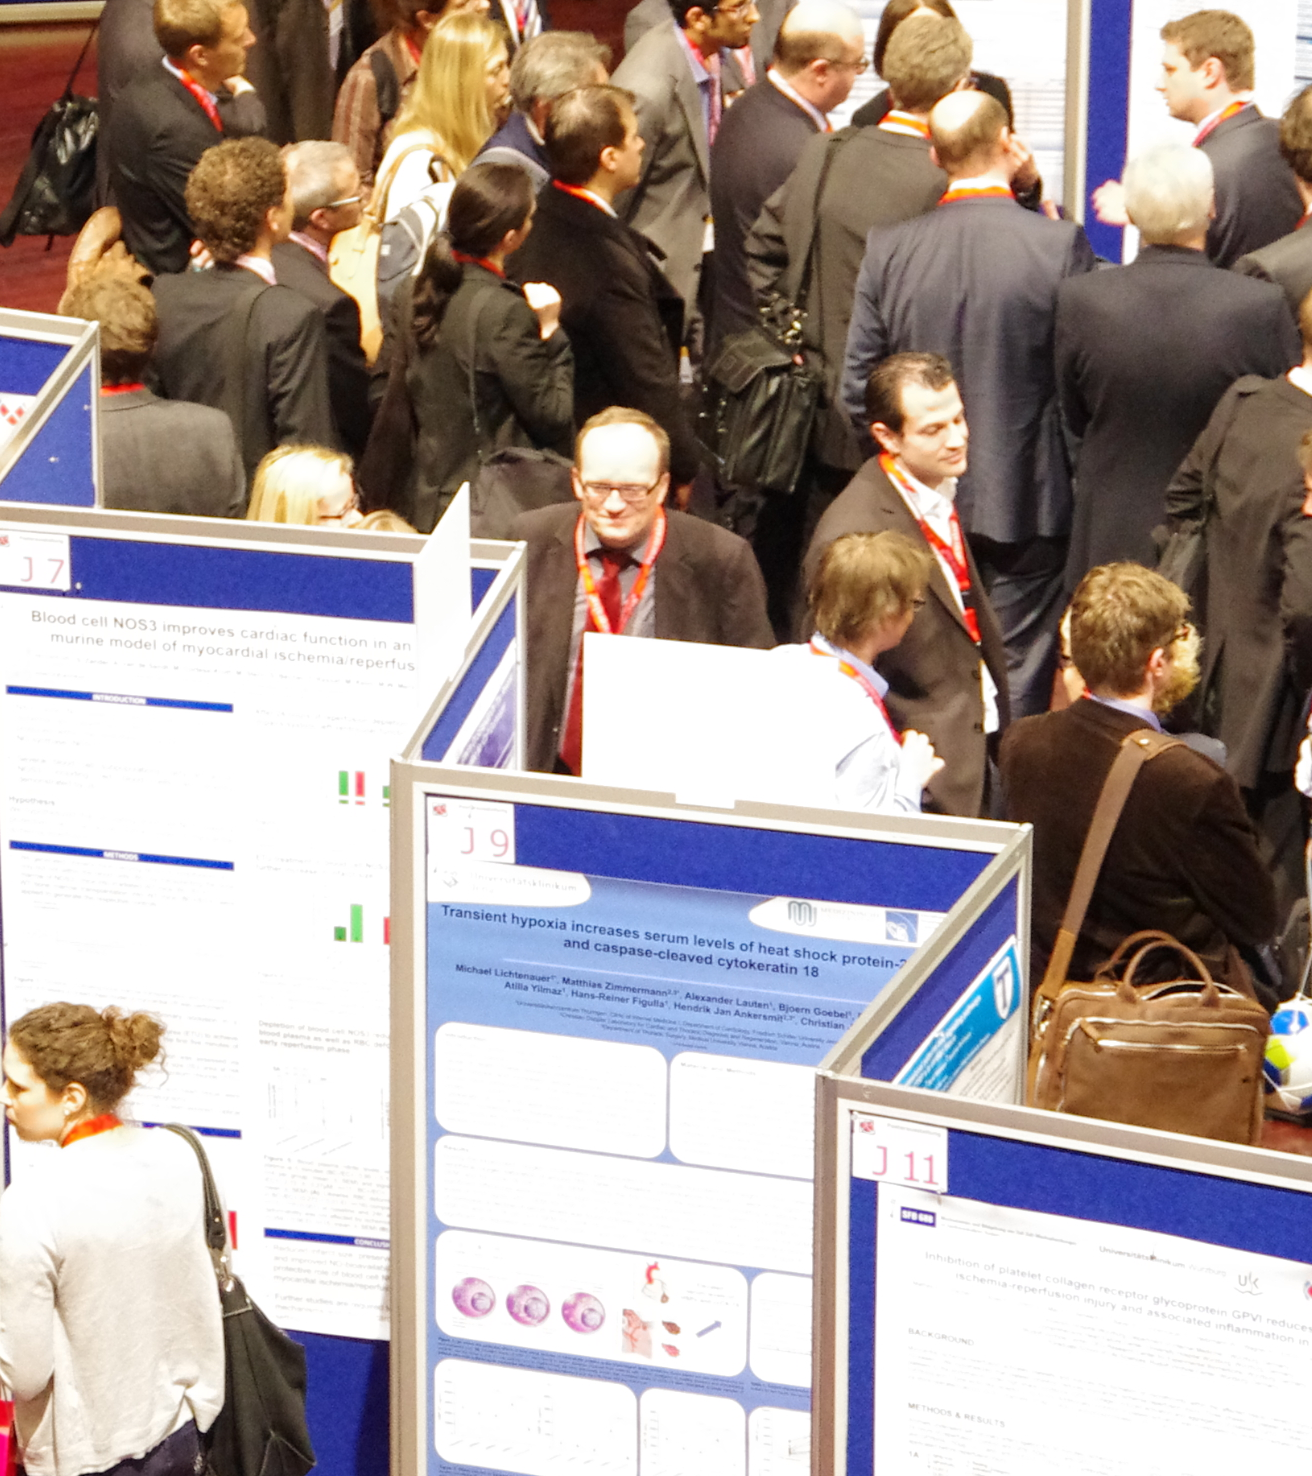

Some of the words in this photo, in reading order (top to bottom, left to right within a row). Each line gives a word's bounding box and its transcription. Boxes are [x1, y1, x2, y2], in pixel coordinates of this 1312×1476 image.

[21, 556, 33, 582] J
[48, 558, 64, 584] 7
[32, 610, 76, 625] Blood
[82, 616, 108, 627] cell
[114, 617, 156, 631] NOS3
[163, 624, 234, 637] improves
[241, 630, 296, 642] cardiac
[303, 632, 367, 647] function
[374, 640, 386, 649] in
[393, 642, 410, 651] an
[51, 634, 104, 646] murine
[110, 639, 156, 650] model
[162, 641, 177, 652] of
[182, 644, 268, 658] myocardial
[94, 695, 145, 704] INTRODUCTION
[104, 852, 138, 860] METHODS
[461, 827, 474, 854] J
[490, 829, 509, 857] 9
[442, 905, 506, 923] Transient
[512, 913, 566, 930] hypoxia
[572, 920, 639, 939] increases
[645, 932, 688, 944] serum
[694, 935, 734, 950] levels
[740, 941, 754, 952] of
[759, 942, 789, 956] heat
[794, 948, 836, 962] shock
[564, 940, 589, 950] and
[594, 943, 712, 964] caspase-cleaved
[718, 958, 797, 974] cytokeratin
[804, 966, 818, 977] 18
[456, 964, 492, 975] Michael
[562, 977, 602, 988] Matthias
[685, 992, 733, 1004] Alexander
[779, 1003, 810, 1014] Bjoern
[504, 982, 528, 991] Atilla
[571, 989, 630, 1003] Hans-Reiner
[674, 1002, 710, 1013] Hendrik
[714, 1007, 731, 1016] Jan
[800, 1017, 844, 1030] Christian
[259, 1020, 294, 1029] Depletion
[872, 1146, 887, 1176] J
[904, 1152, 938, 1185] 11
[902, 1209, 917, 1220] SFB
[926, 1252, 979, 1268] Inhibition
[984, 1263, 995, 1271] of
[999, 1267, 1041, 1280] platelet
[1046, 1276, 1095, 1290] collagen
[1100, 1286, 1148, 1300] receptor
[1153, 1296, 1227, 1316] glycoprotein
[1232, 1310, 1262, 1322] GPVI
[1267, 1318, 1312, 1333] reduces
[956, 1273, 1079, 1301] ischemia-reperfusion
[1084, 1298, 1116, 1311] injury
[1121, 1305, 1142, 1314] and
[1147, 1310, 1211, 1328] associated
[1216, 1323, 1294, 1342] inflammation
[908, 1328, 974, 1346] BACKGROUND
[908, 1402, 952, 1416] METHODS
[964, 1414, 1005, 1428] RESULTS
